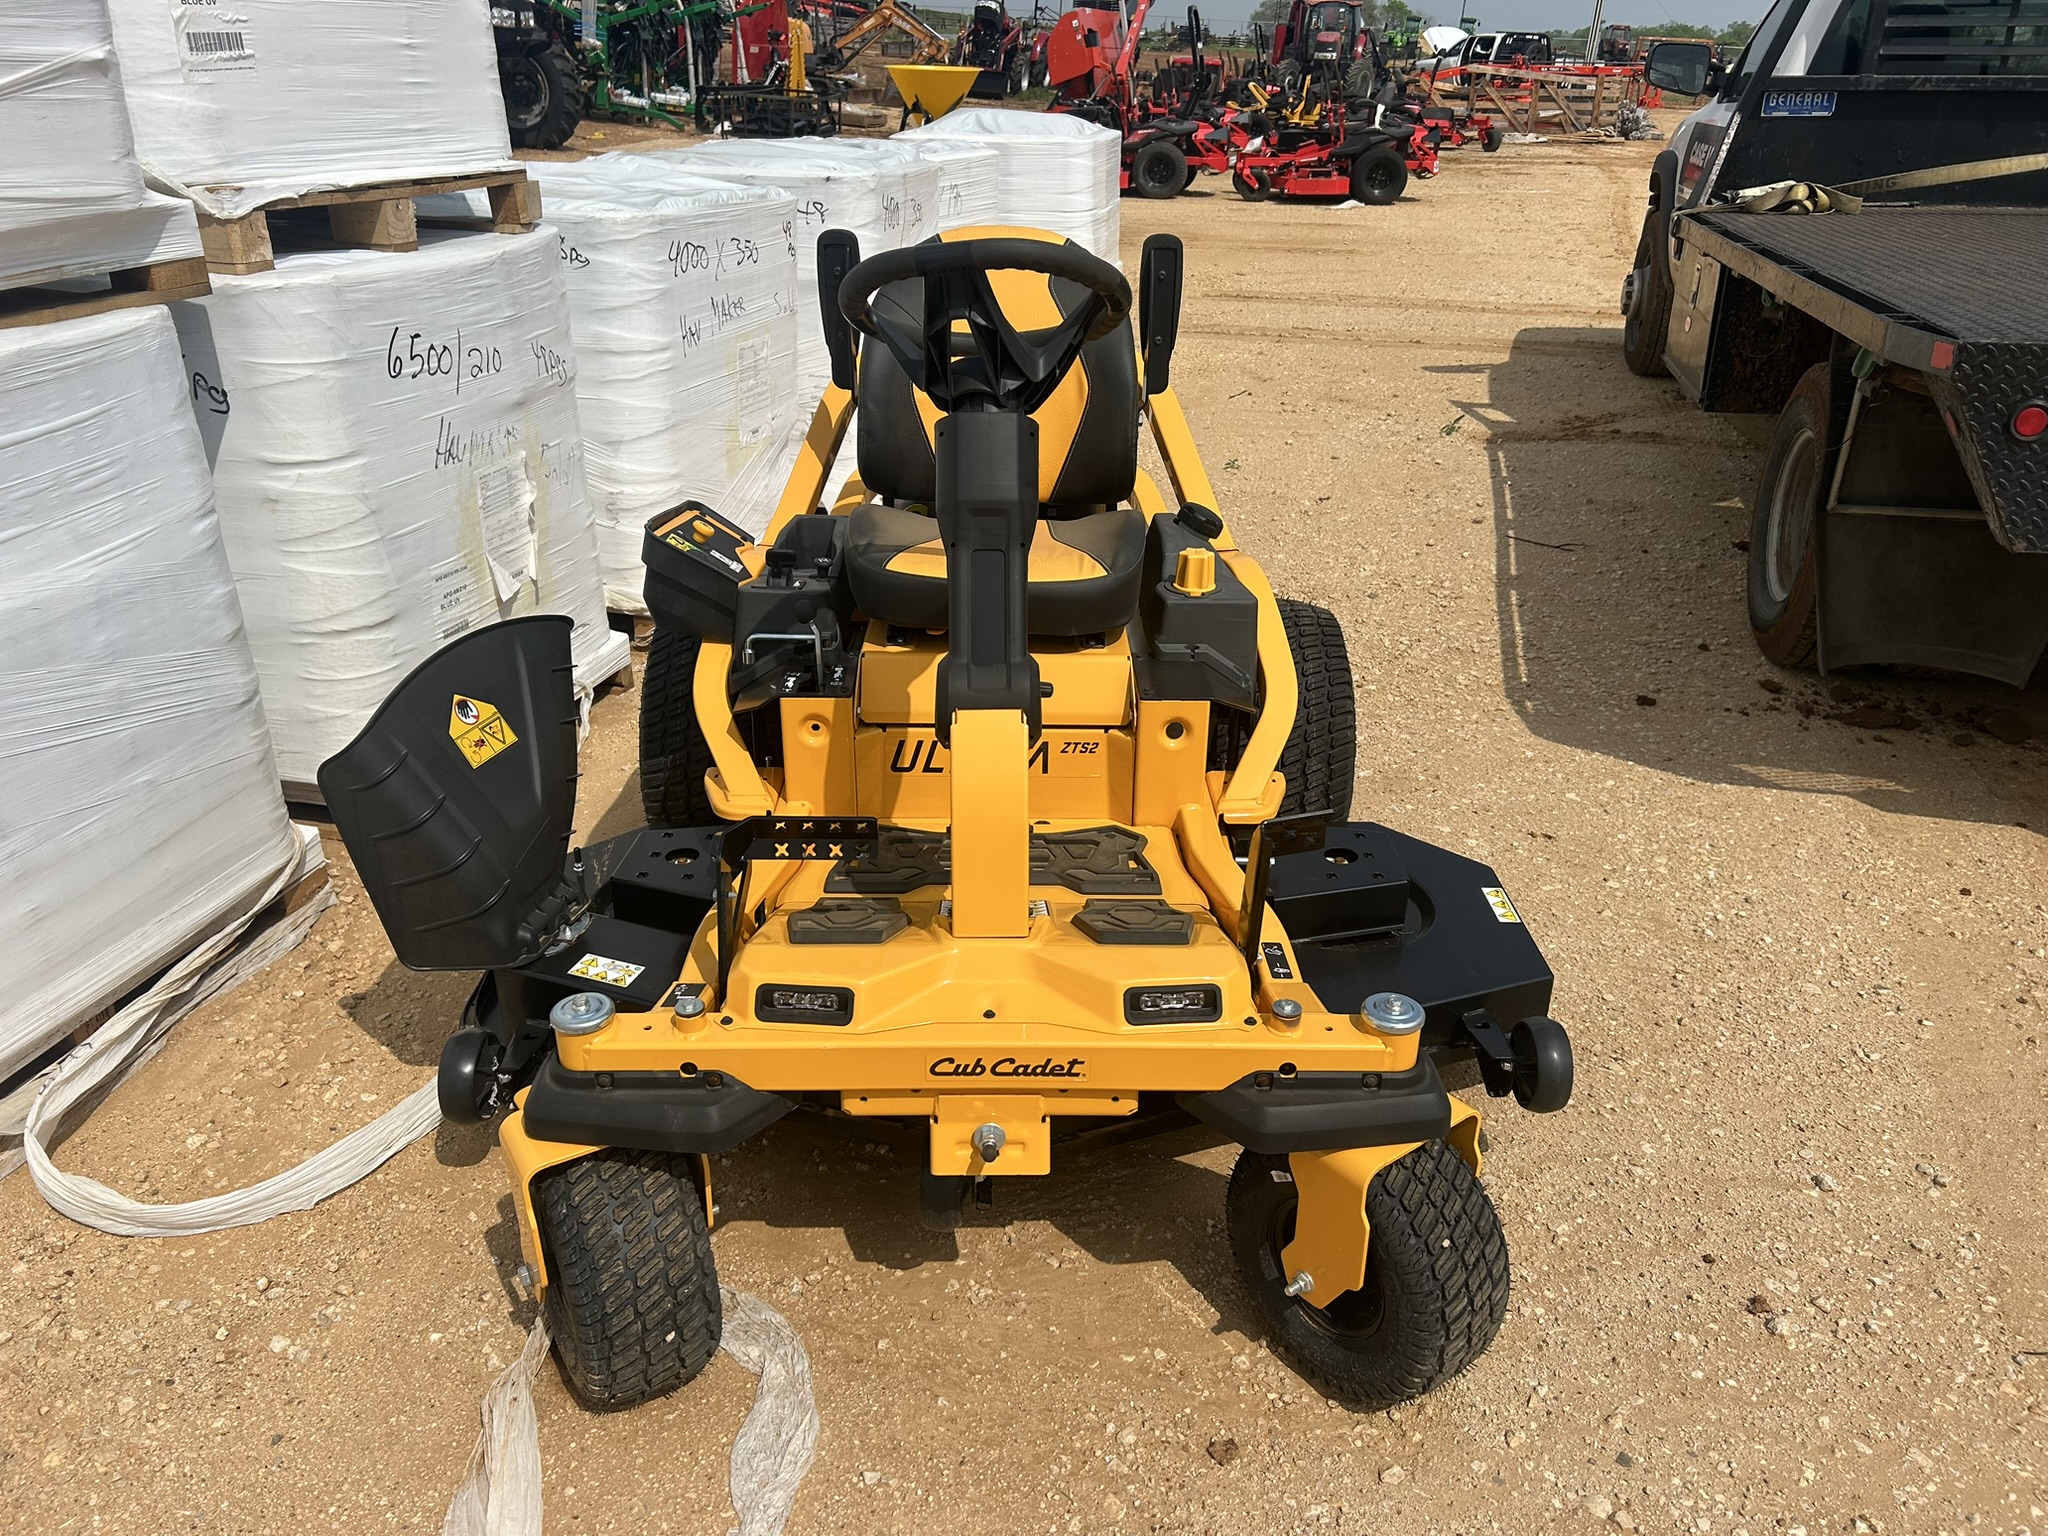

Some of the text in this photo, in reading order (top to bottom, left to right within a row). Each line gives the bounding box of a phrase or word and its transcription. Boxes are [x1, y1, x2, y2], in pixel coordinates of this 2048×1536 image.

[892, 16, 912, 31] CASE
[1769, 93, 1830, 107] GENERAL
[1690, 140, 1709, 167] CASE
[668, 240, 710, 277] 4000
[730, 237, 760, 266] 350
[889, 739, 1100, 775] ULA ZTS2
[929, 1057, 1086, 1078] Cub Cadet
